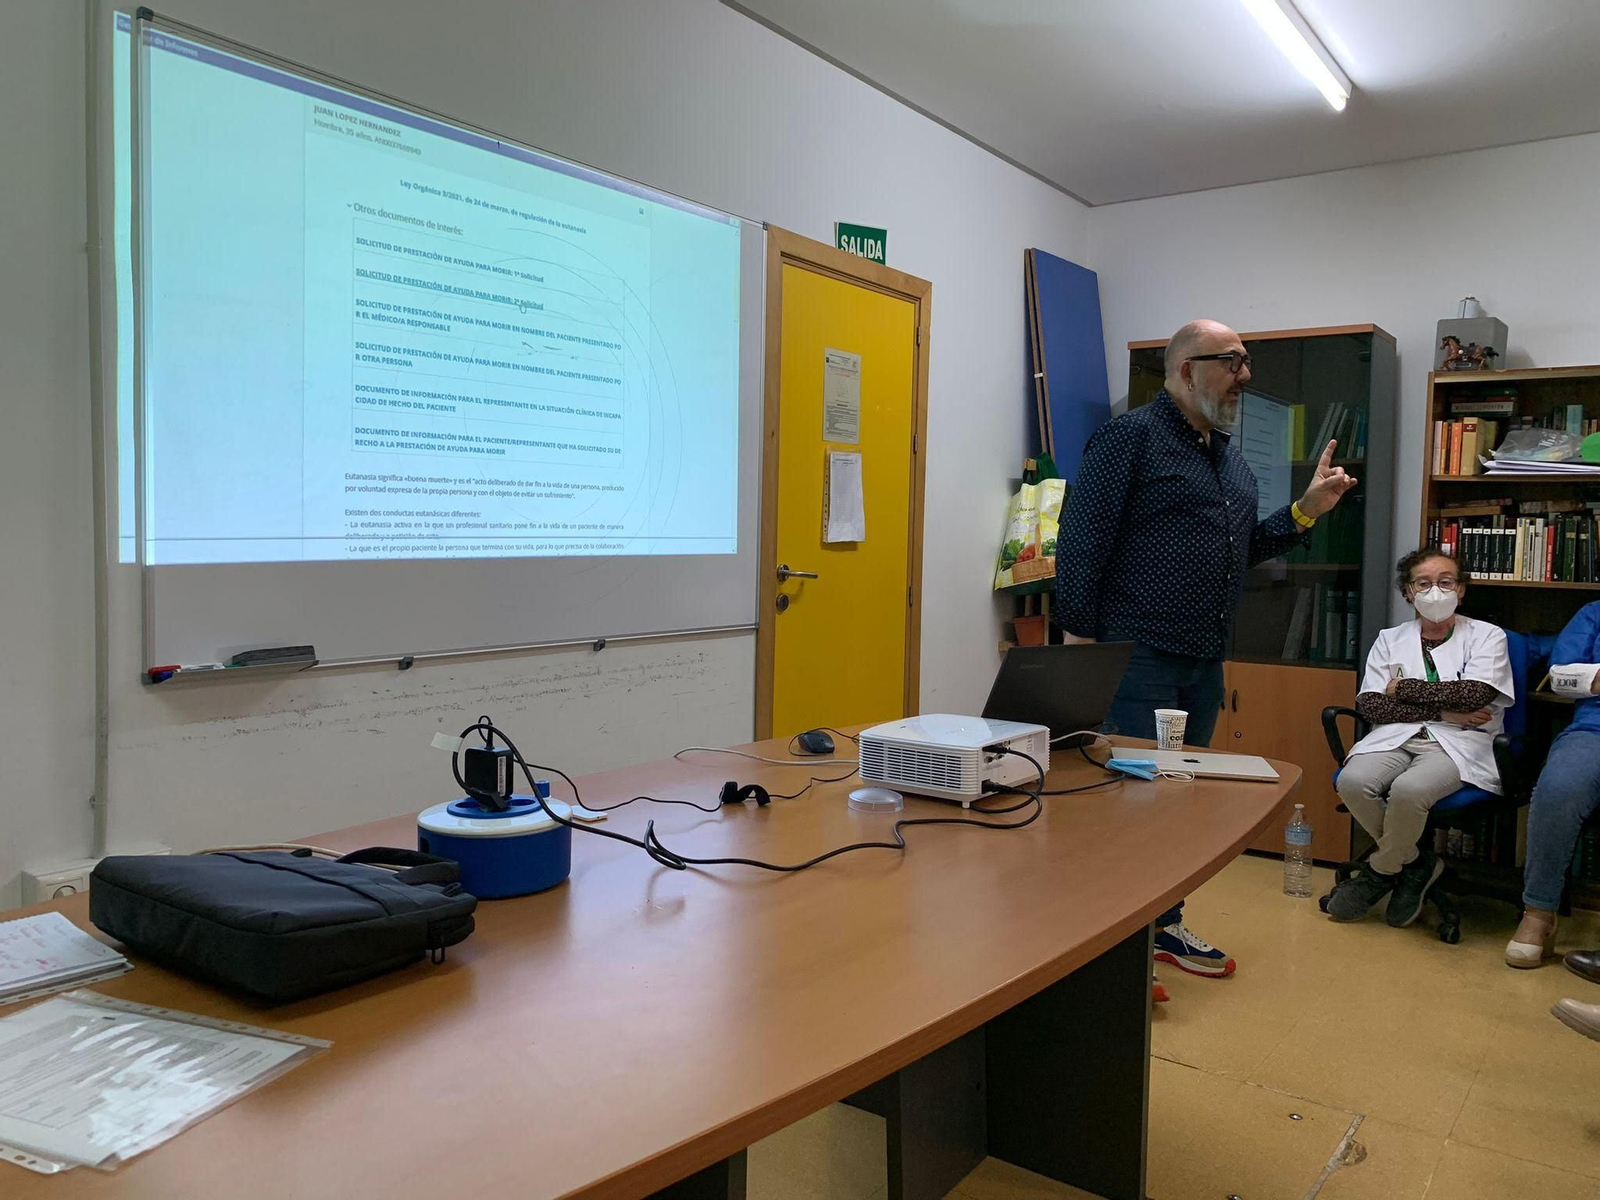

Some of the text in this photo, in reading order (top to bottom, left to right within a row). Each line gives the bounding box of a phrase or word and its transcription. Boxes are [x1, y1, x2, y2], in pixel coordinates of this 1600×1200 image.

[313, 104, 400, 137] JUAN LOPEZ HERNANDEZ
[353, 202, 376, 215] Otros
[377, 207, 424, 226] documentos
[425, 219, 435, 229] de
[355, 236, 391, 251] SOLICITUD
[393, 244, 402, 253] DE
[403, 245, 442, 261] PRESTACIÓN
[443, 255, 452, 263] DE
[452, 257, 474, 268] AYUDA
[475, 262, 491, 271] PARA
[492, 265, 513, 276] MORIR:
[520, 271, 543, 282] Solicitud
[840, 234, 883, 260] SALIDA
[355, 267, 391, 282] SOLICITUD
[402, 275, 442, 292] PRESTACIÓN
[452, 286, 473, 297] AYUDA
[475, 290, 491, 301] PARA
[492, 293, 513, 305] MORIR:
[520, 299, 543, 310] Solicitud
[355, 298, 391, 311] SOLICITUD
[393, 305, 402, 313] DE
[402, 305, 442, 320] PRESTACIÓN
[443, 313, 452, 321] DE
[452, 315, 473, 325] AYUDA
[475, 319, 491, 328] PARA
[491, 322, 511, 331] MORIR
[511, 325, 519, 333] EN
[520, 327, 544, 337] NOMBRE
[545, 331, 555, 339] DEL
[556, 333, 581, 343] PACIENTE
[581, 337, 613, 349] PRESENTADO
[361, 311, 370, 319] EL
[371, 311, 405, 325] MÉDICO/A
[406, 319, 450, 332] RESPONSABLE
[355, 341, 391, 353] SOLICITUD
[392, 346, 401, 354] DE
[402, 346, 442, 360] PRESTACIÓN
[452, 355, 473, 364] AYUDA
[475, 358, 490, 367] PARA
[491, 361, 511, 370] MORIR
[511, 363, 519, 371] EN
[520, 365, 544, 374] NOMBRE
[545, 368, 555, 376] DEL
[556, 370, 580, 379] PACIENTE
[581, 373, 613, 384] PRESENTADO
[361, 354, 380, 363] OTRA
[381, 356, 412, 367] PERSONA
[355, 384, 399, 395] DOCUMENTO
[400, 389, 409, 397] DE
[411, 389, 456, 402] INFORMACIÓN
[458, 395, 474, 403] PARA
[483, 398, 528, 409] REPRESENTANTE
[546, 404, 574, 414] SITUACIÓN
[575, 407, 595, 416] CLÍNICA
[355, 396, 376, 405] CIDAD
[377, 398, 387, 406] DE
[388, 399, 411, 408] HECHO
[426, 403, 455, 412] PACIENTE
[354, 427, 399, 437] DOCUMENTO
[411, 430, 456, 441] INFORMACIÓN
[483, 437, 555, 449] PACIENTE/REPRESENTANTE
[577, 445, 606, 453] SOLICITADO
[354, 438, 378, 447] RECHO
[396, 440, 436, 451] PRESTACIÓN
[446, 445, 468, 453] AYUDA
[469, 446, 485, 454] PARA
[344, 472, 376, 481] Eutanasia
[377, 474, 403, 483] significa
[601, 484, 624, 492] producido
[428, 487, 448, 495] propia
[495, 490, 512, 498] objeto
